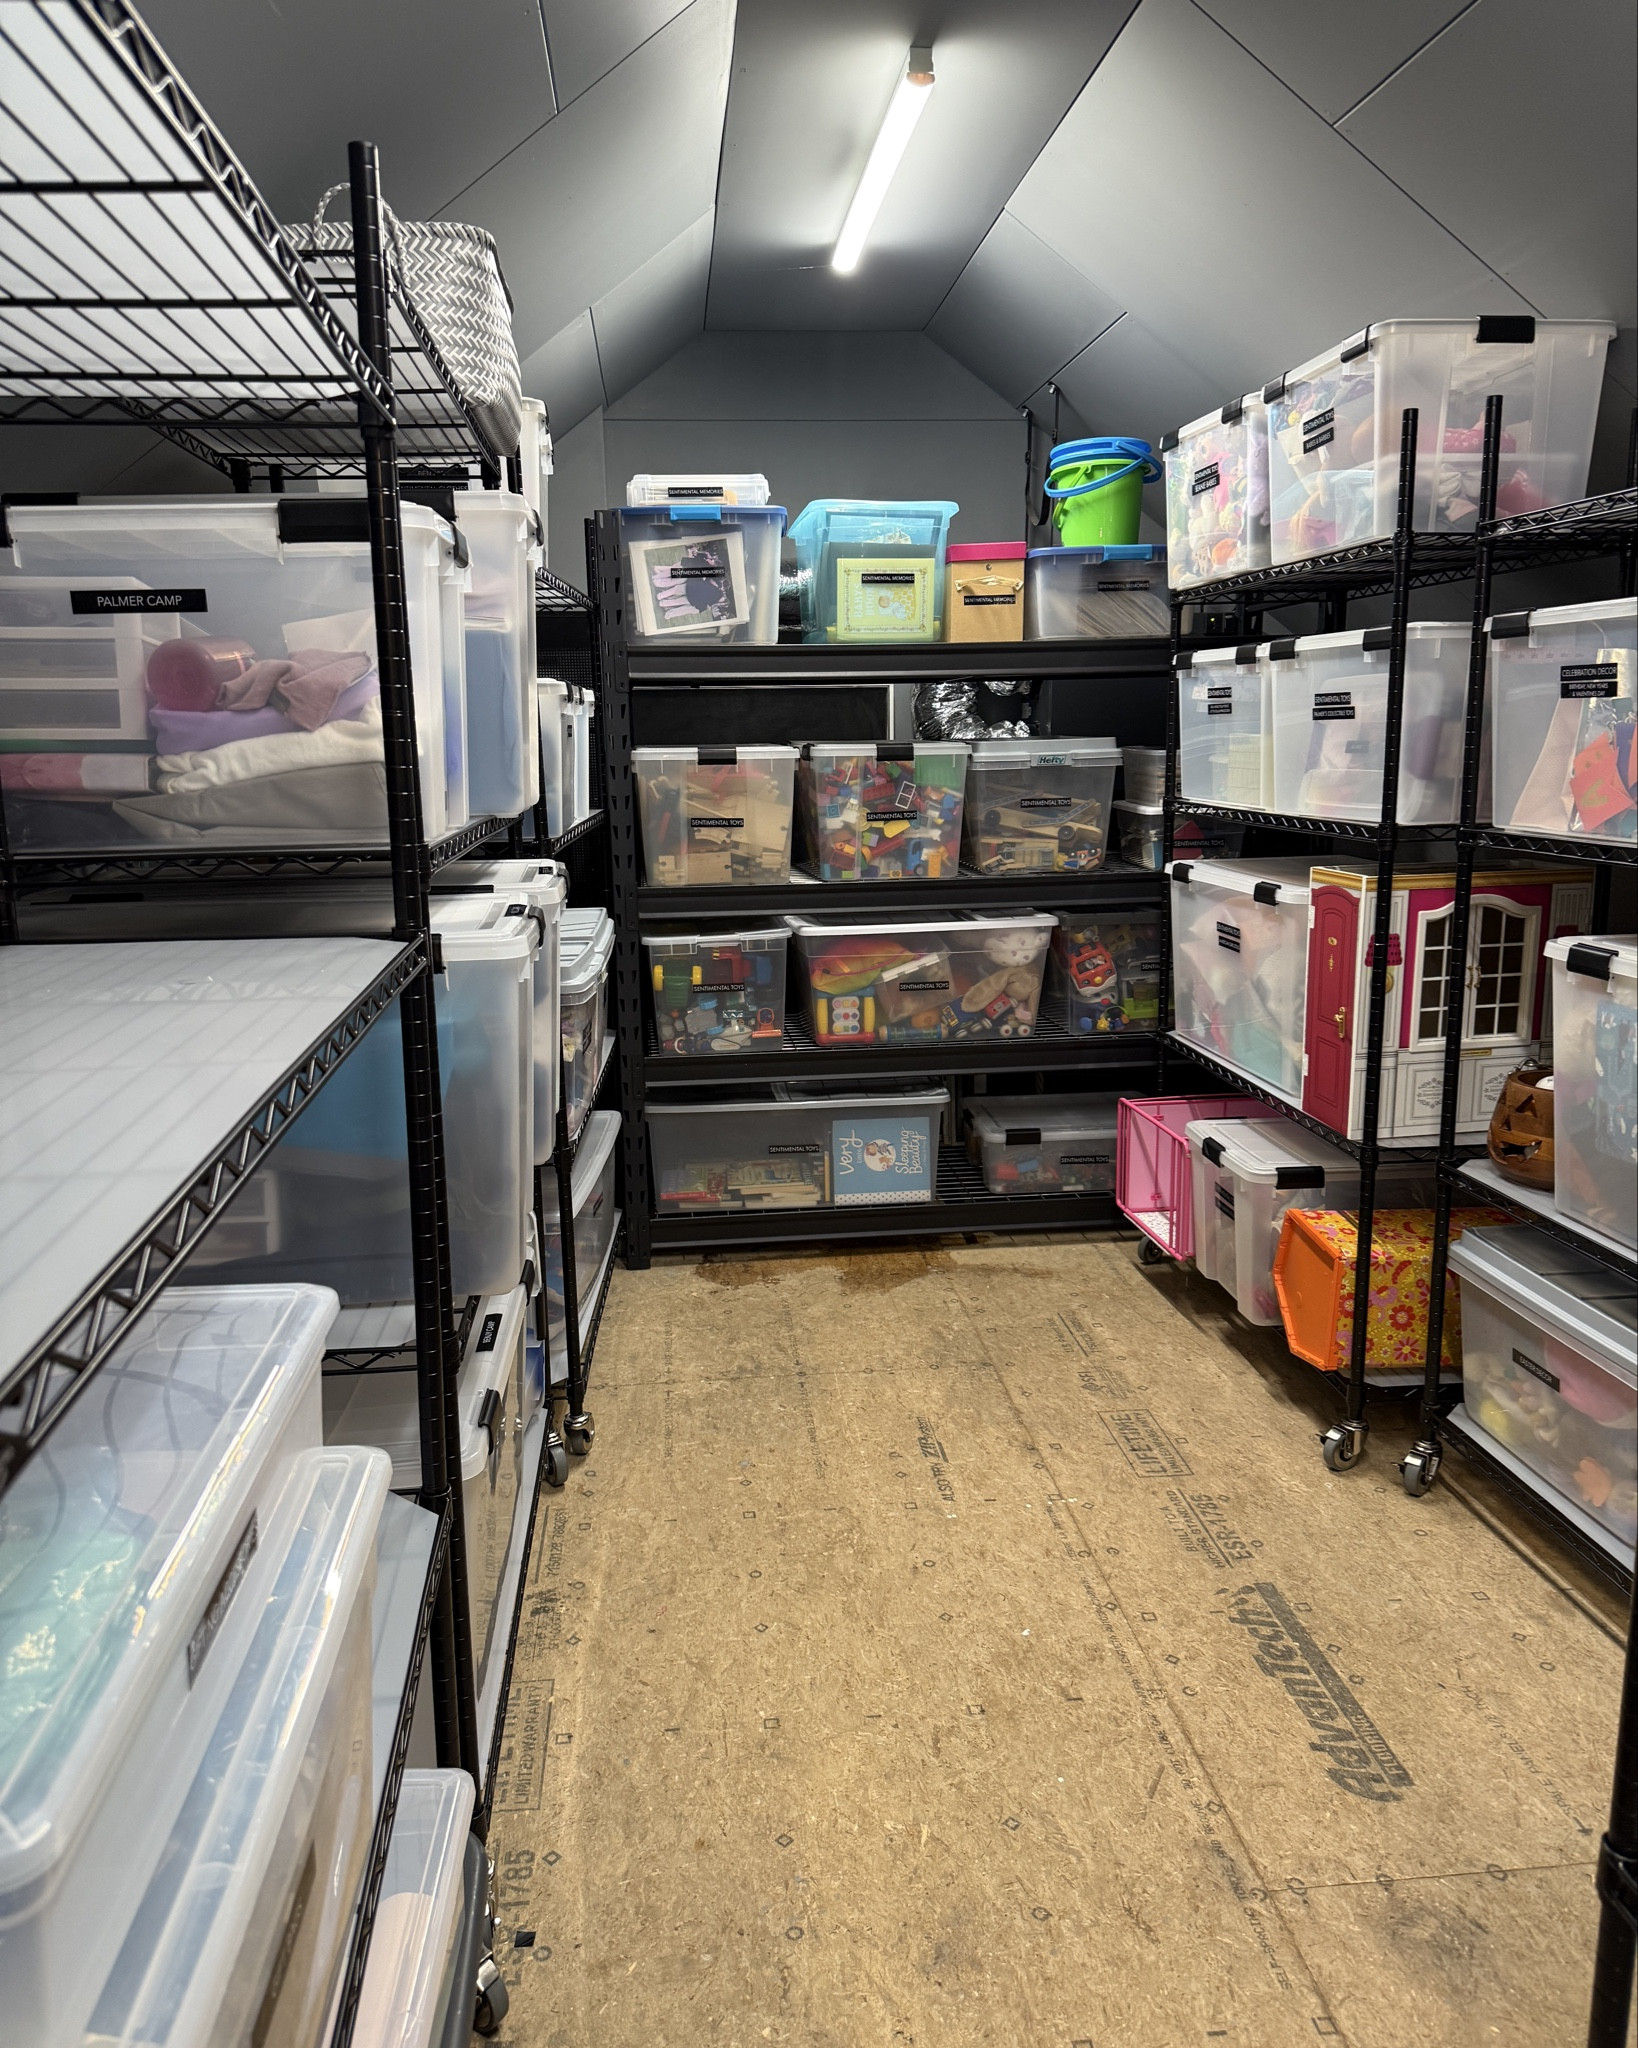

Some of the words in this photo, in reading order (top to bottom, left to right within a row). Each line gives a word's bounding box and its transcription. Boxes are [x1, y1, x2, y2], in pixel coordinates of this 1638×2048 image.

[862, 574, 892, 582] SENTIMENTAL
[97, 596, 145, 607] PALMER
[146, 595, 183, 607] CAMP
[994, 595, 1016, 603] MEMORIES
[1562, 668, 1597, 677] CELEBRATION
[1597, 666, 1616, 676] DECOR
[1039, 755, 1065, 764] Hefty
[1021, 800, 1057, 808] SENTIMENTAL
[1057, 799, 1071, 807] TOYS
[691, 818, 729, 827] SENTIMENTAL
[729, 818, 744, 826] TOYS
[867, 812, 903, 821] SENTIMENTAL
[903, 811, 918, 819] TOYS
[1174, 839, 1210, 847] SENTIMENTAL
[1211, 838, 1225, 846] TOYS
[693, 985, 730, 993] SENTIMENTAL
[839, 1129, 864, 1175] Very
[894, 1126, 915, 1174] Sleeping
[909, 1131, 927, 1175] Beauty
[1134, 1412, 1164, 1449] WARRANTY
[1111, 1412, 1168, 1474] LIFETIME
[929, 1461, 945, 1478] TRY
[1157, 1448, 1184, 1474] LIMITED
[937, 1479, 955, 1502] ALSO
[1165, 1513, 1180, 1525] TO
[1166, 1490, 1202, 1535] STANDARD
[1189, 1493, 1255, 1561] ESR-1785
[1172, 1527, 1198, 1552] BUILT
[1197, 1536, 1225, 1569] HIGHER
[518, 1684, 541, 1751] WARRANTY
[1157, 1729, 1175, 1755] CLOSE
[1350, 1713, 1403, 1776] FLOORING
[513, 1751, 533, 1805] LIMITED
[1169, 1758, 1186, 1776] NOT
[1180, 1778, 1194, 1790] DO
[1211, 1839, 1228, 1858] AND
[1243, 1907, 1293, 1991] SELF-SPACING
